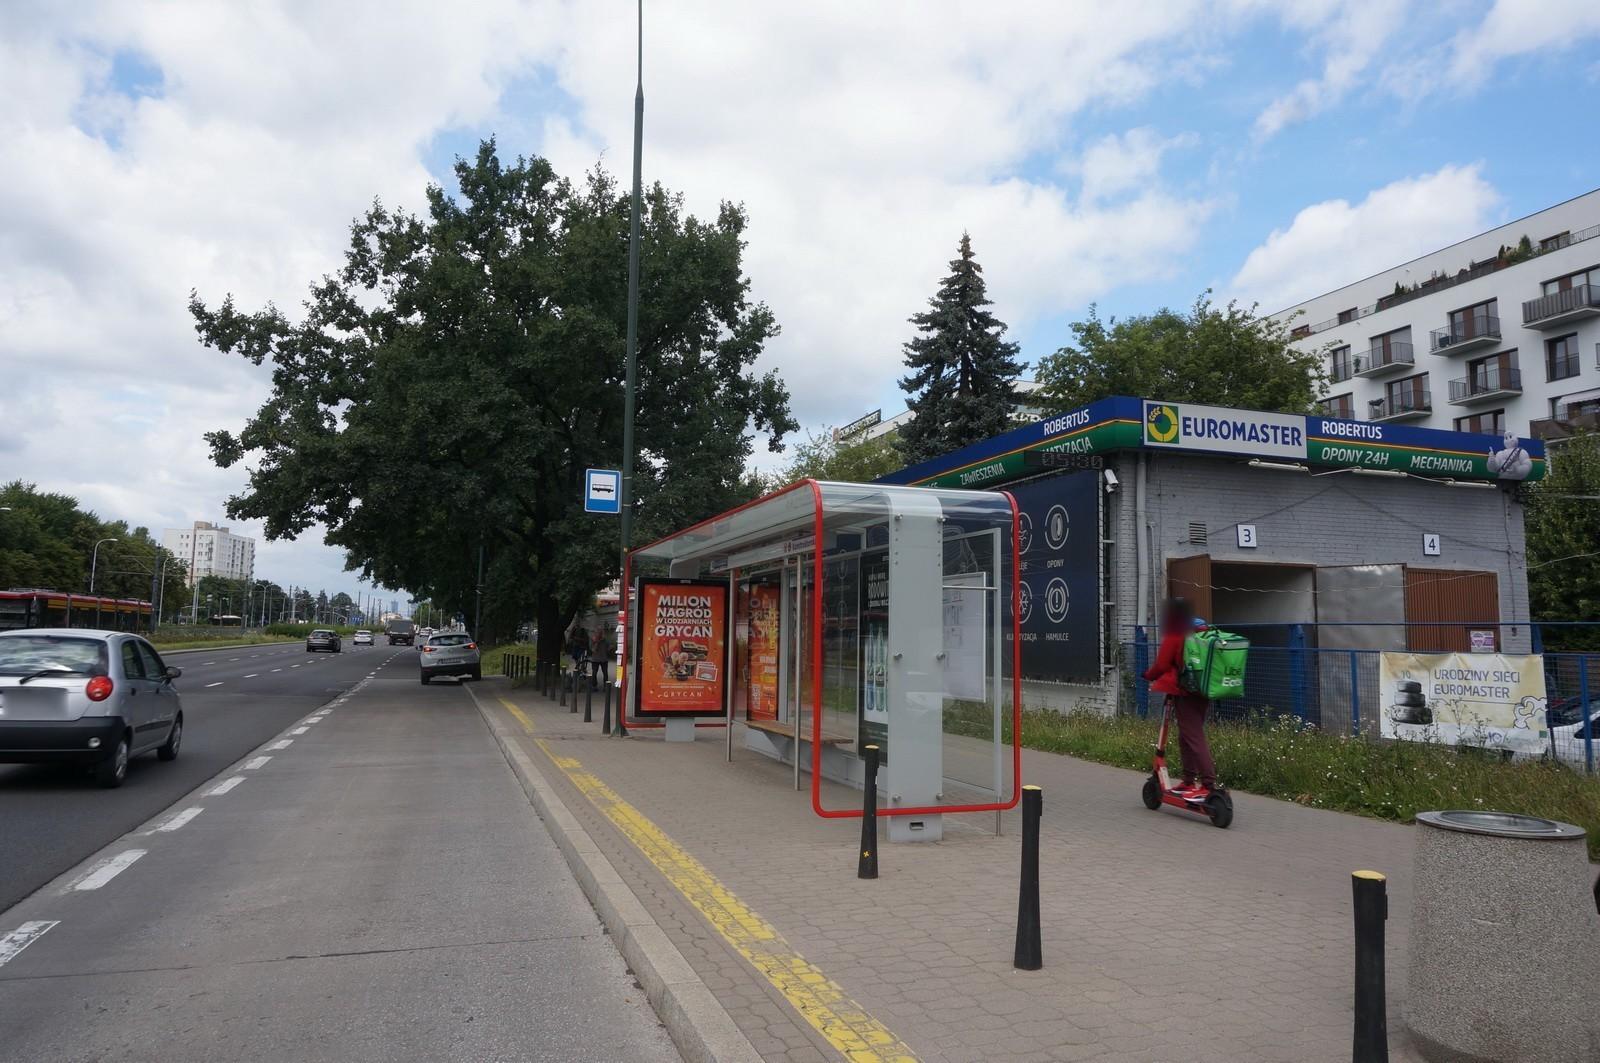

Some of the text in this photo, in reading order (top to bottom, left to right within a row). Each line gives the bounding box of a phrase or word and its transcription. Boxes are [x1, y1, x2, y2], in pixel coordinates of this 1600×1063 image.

[1043, 409, 1090, 436] ROBERTUS
[1321, 420, 1382, 439] ROBERTUS
[1182, 416, 1302, 446] EUROMASTER
[1321, 447, 1389, 465] OPONY 24H
[1410, 455, 1472, 473] MECHANIKA
[959, 462, 1006, 485] ZAWIESZENIA
[1243, 529, 1251, 542] 3
[1428, 538, 1436, 550] 4
[1046, 559, 1065, 569] OPONY
[658, 594, 711, 607] MILION
[656, 605, 712, 618] NAGRÓD
[655, 625, 713, 638] GRYCAN
[1045, 632, 1070, 641] HAMULCE
[1434, 669, 1520, 683] URODZINY SIECI
[1434, 684, 1510, 699] EUROMASTER
